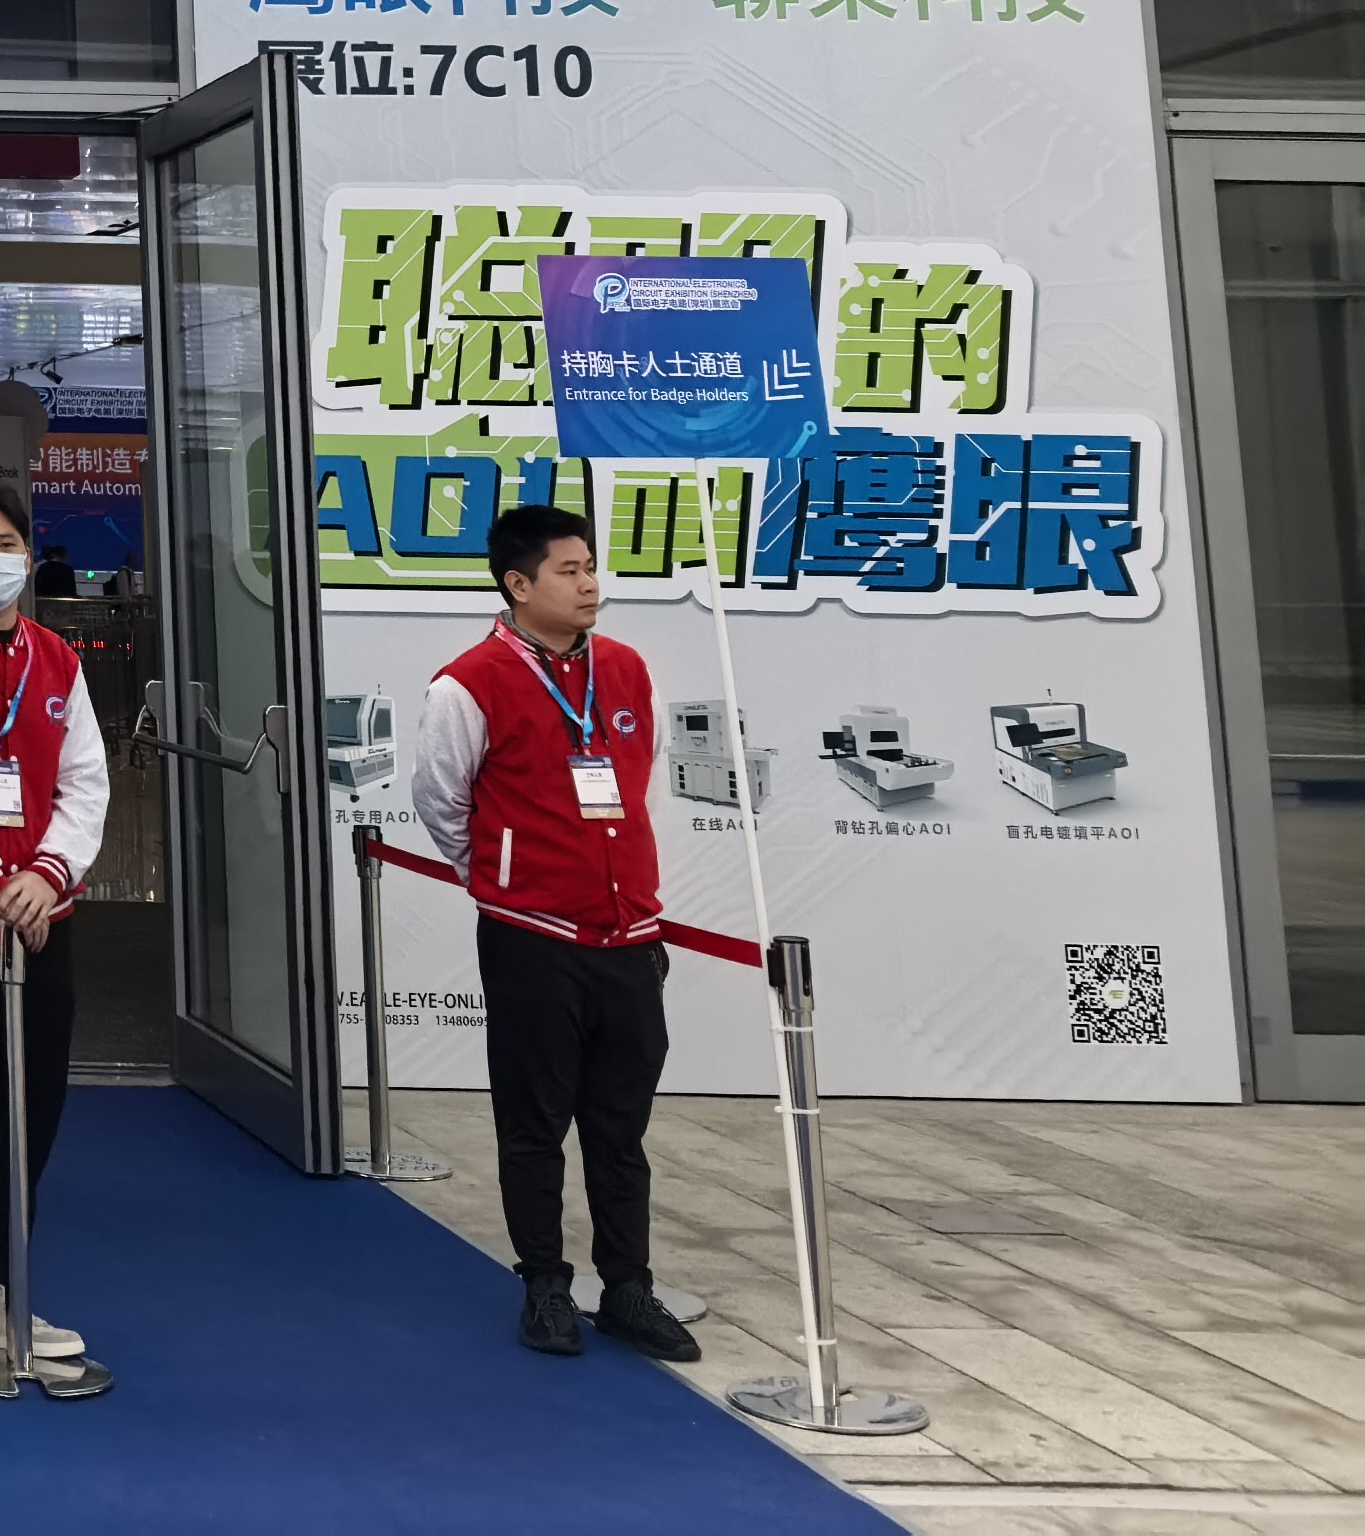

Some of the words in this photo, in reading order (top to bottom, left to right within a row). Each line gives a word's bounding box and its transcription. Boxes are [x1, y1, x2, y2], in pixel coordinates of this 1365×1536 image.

[561, 350, 744, 378] 持胸卡人士通道
[565, 387, 626, 402] Entrance
[628, 386, 648, 402] for
[651, 388, 694, 405] Badge
[696, 387, 749, 402] Holders
[835, 819, 952, 836] 背钻孔偏心AOI
